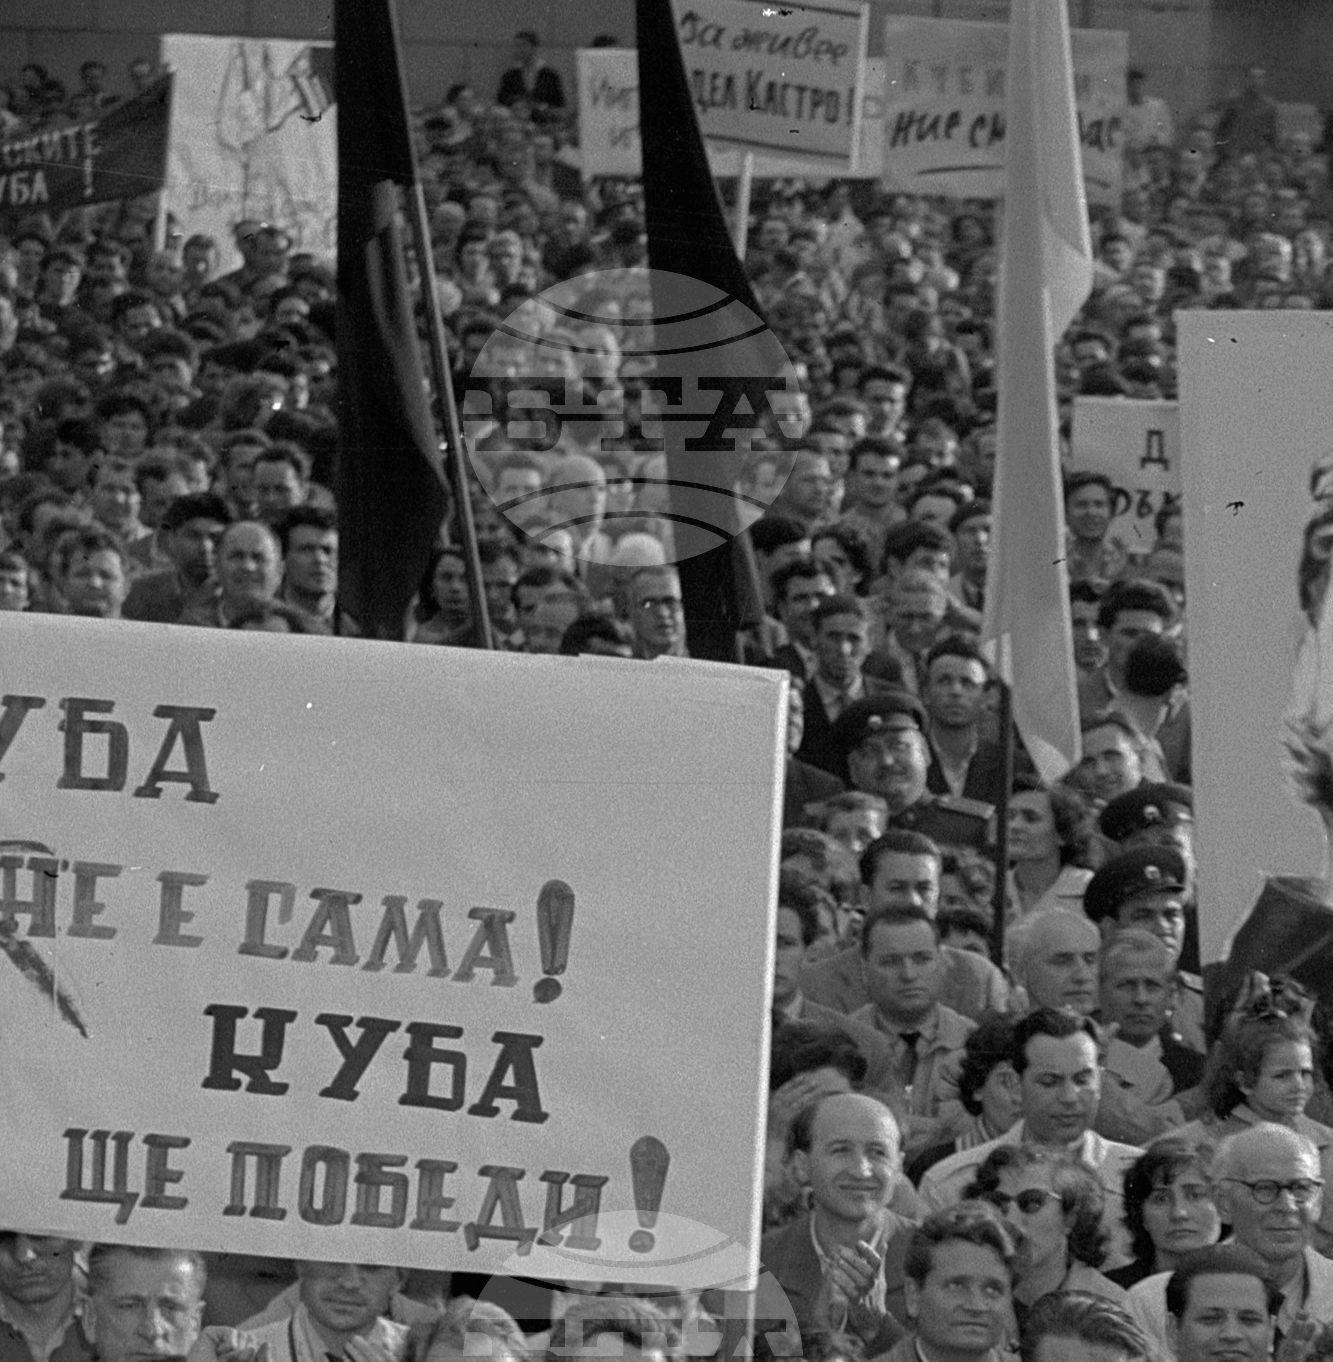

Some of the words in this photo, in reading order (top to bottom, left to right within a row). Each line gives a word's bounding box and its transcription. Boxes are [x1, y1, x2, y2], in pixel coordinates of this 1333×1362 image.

[152, 870, 211, 947] Е
[238, 877, 576, 1005] САМА!
[201, 1003, 550, 1124] КУБА
[59, 1127, 192, 1224] ЩЕ
[222, 1135, 671, 1255] ПОБЕДИ!
